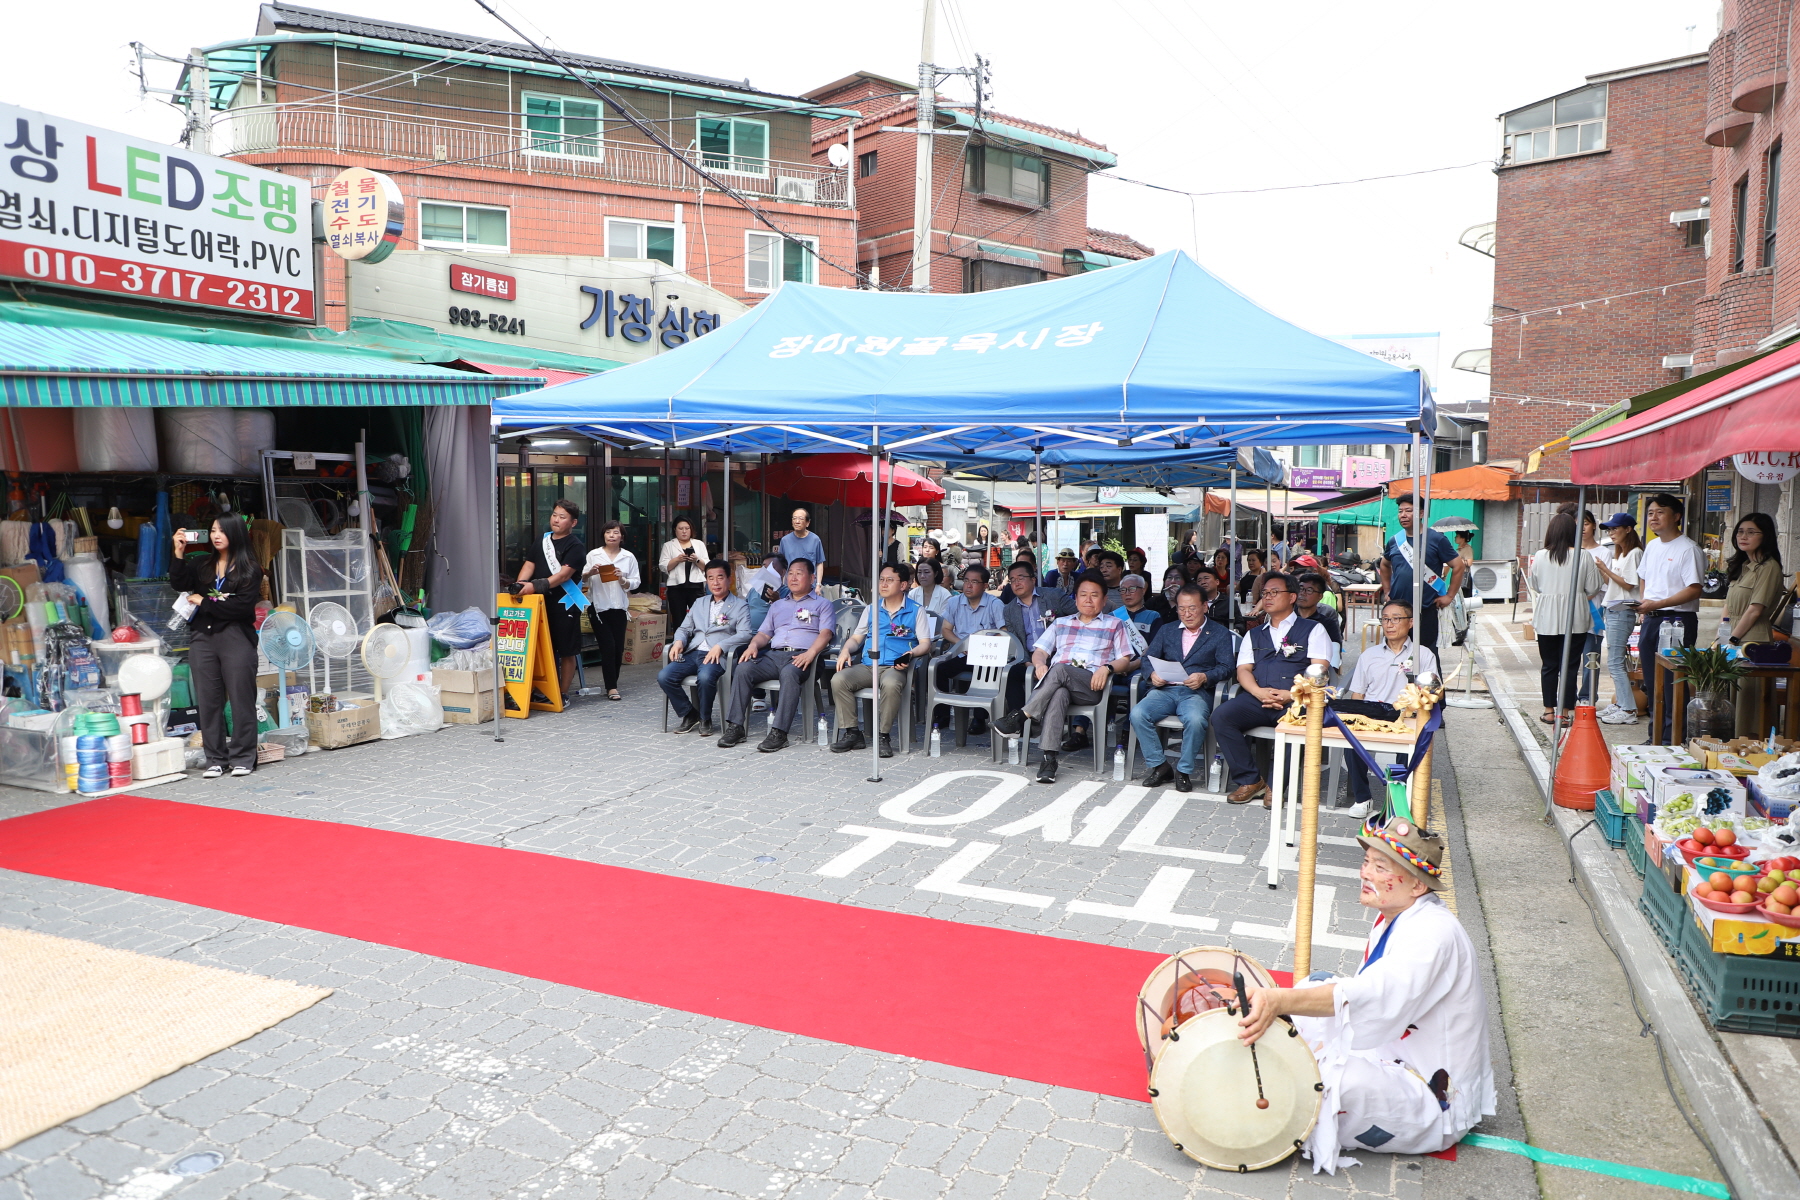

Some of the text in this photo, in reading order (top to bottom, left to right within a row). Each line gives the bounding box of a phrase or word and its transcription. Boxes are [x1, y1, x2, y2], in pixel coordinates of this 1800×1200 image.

[4, 117, 64, 183] 상
[331, 176, 378, 197] 철물
[331, 193, 378, 214] 전기
[330, 212, 379, 232] 수도
[329, 230, 380, 250] 열쇠복사
[23, 247, 301, 315] 010-3717-2312
[461, 271, 509, 295] 참기름집
[449, 305, 526, 336] 993-5241
[1358, 461, 1386, 479] 핑크공주
[1756, 471, 1784, 481] 수유점
[503, 609, 526, 618] 최고가로
[497, 638, 526, 653] 삽니다
[497, 654, 524, 668] 지털도어
